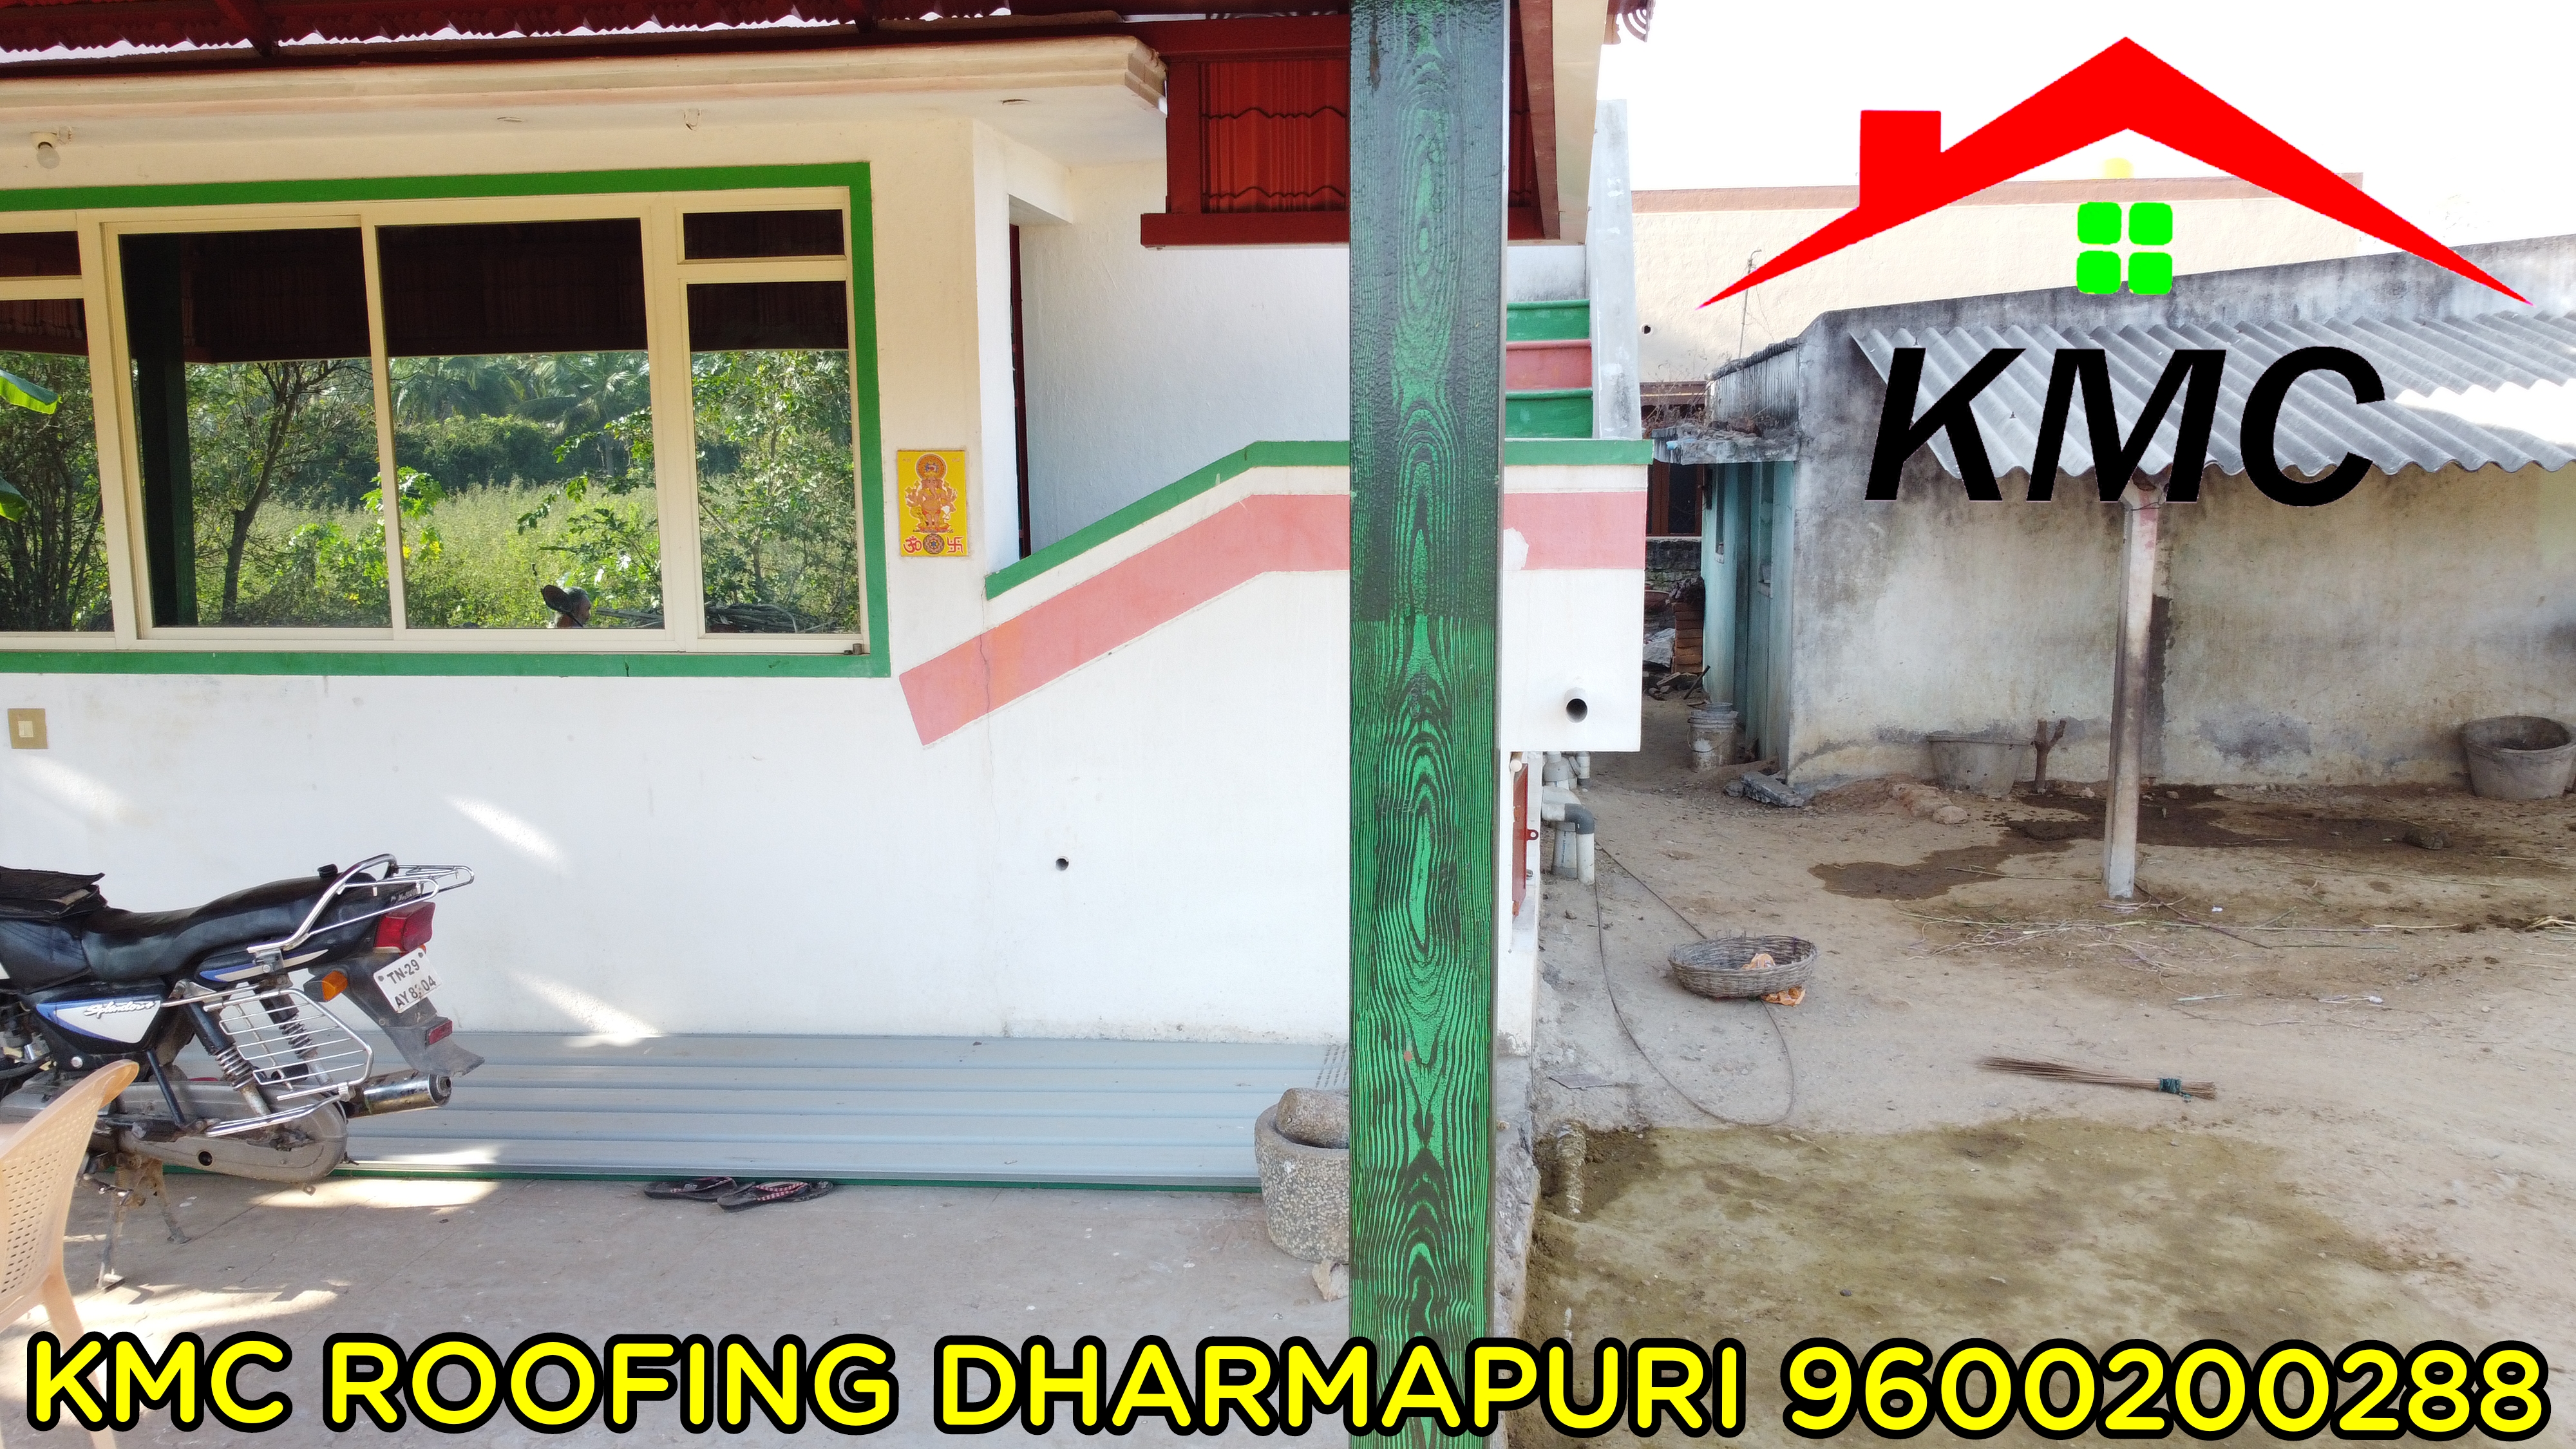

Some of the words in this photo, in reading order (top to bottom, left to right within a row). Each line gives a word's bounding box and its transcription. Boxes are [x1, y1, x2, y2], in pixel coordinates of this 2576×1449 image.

[386, 959, 420, 985] TN-29
[394, 990, 410, 1009] AY
[408, 974, 437, 999] 804
